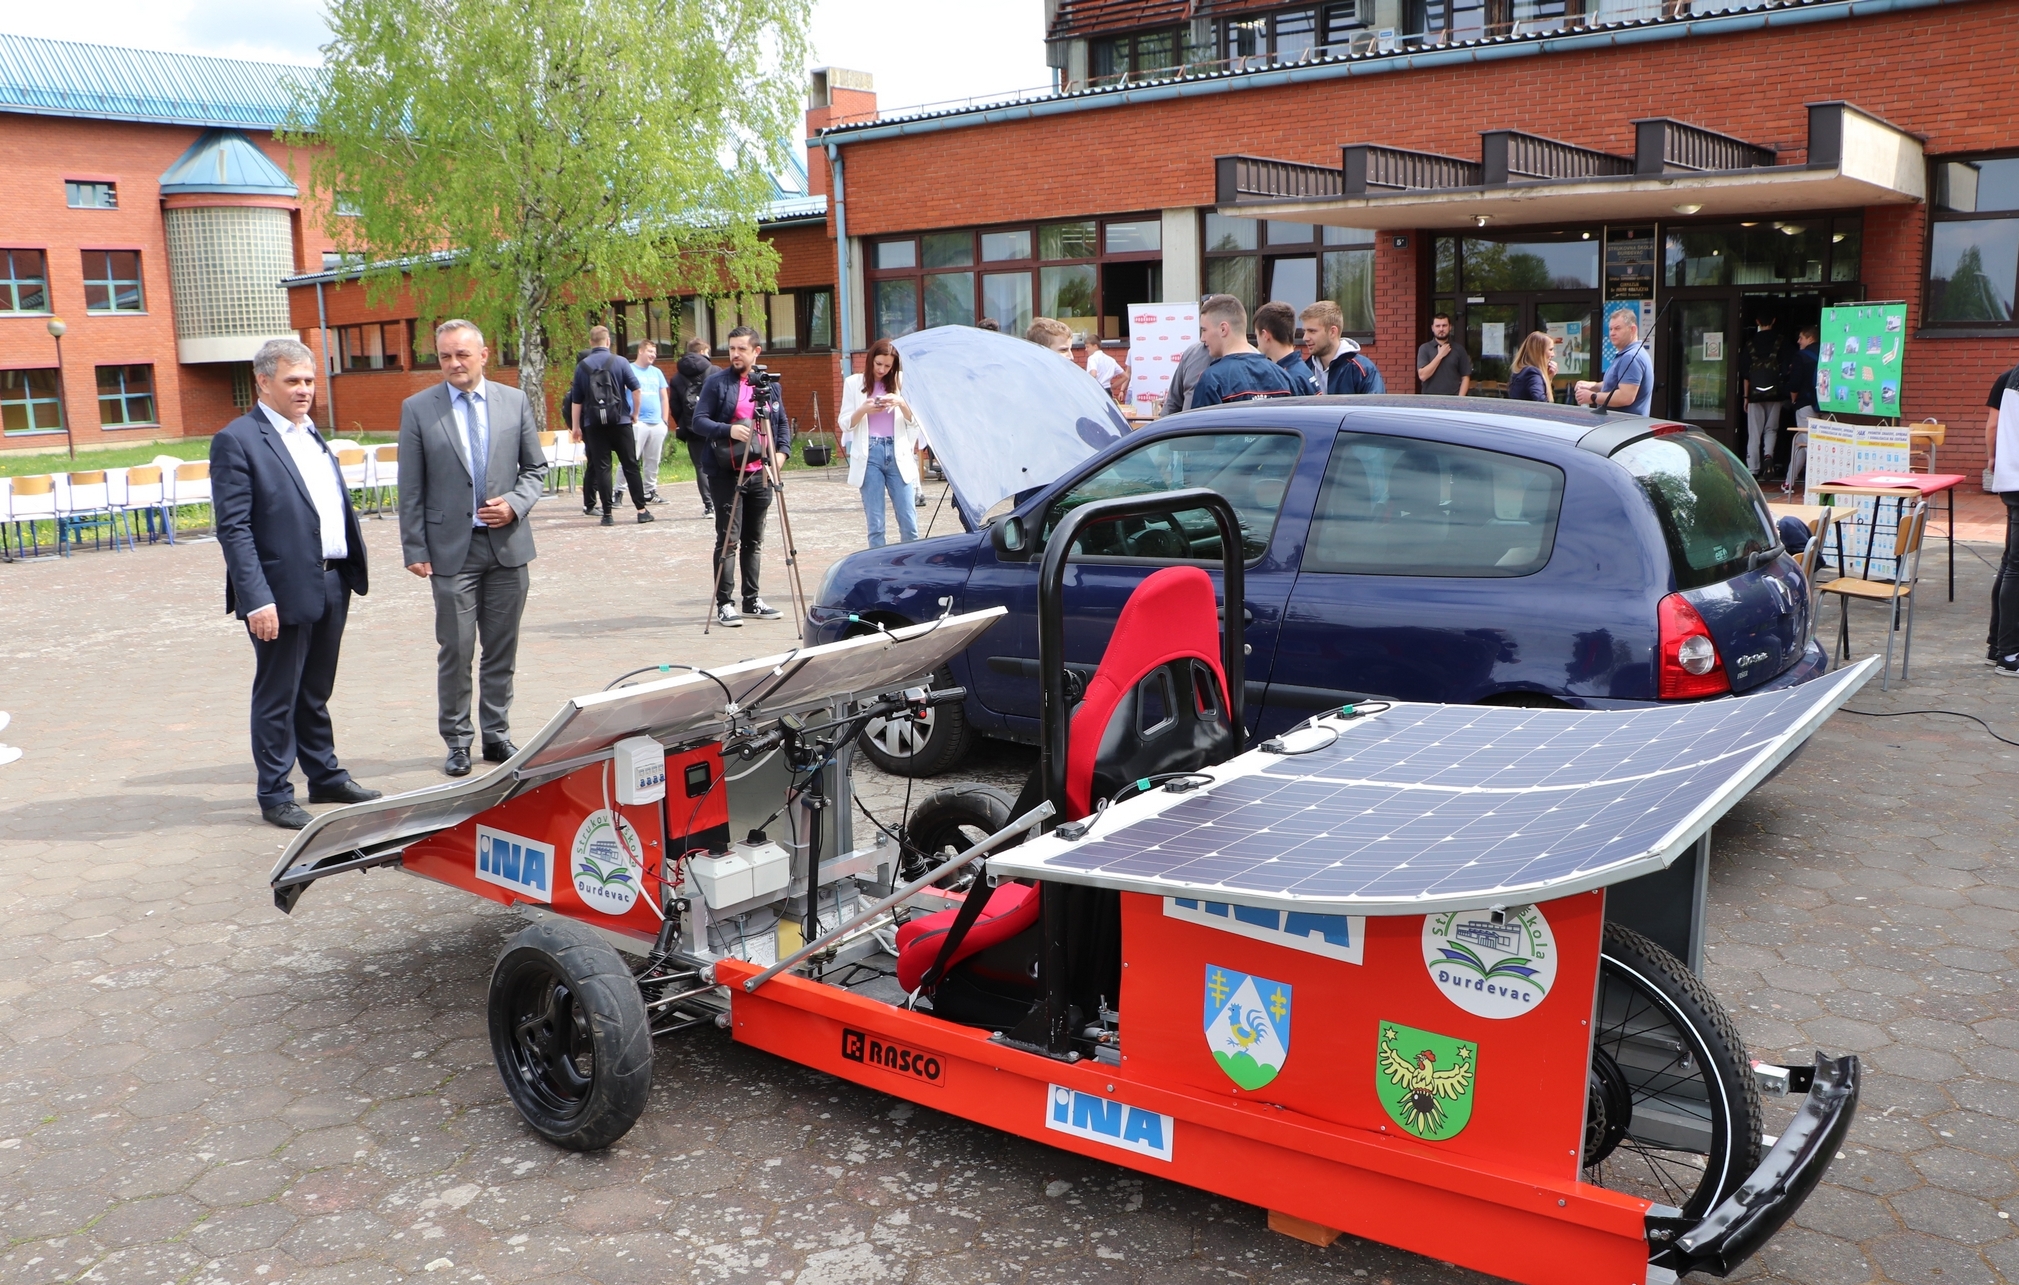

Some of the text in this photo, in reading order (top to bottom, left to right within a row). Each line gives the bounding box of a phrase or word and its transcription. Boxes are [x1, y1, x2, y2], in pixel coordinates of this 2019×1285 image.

[578, 881, 630, 902] Đurđevac
[1438, 970, 1531, 1003] Đurđevac
[869, 1040, 941, 1081] RASCO
